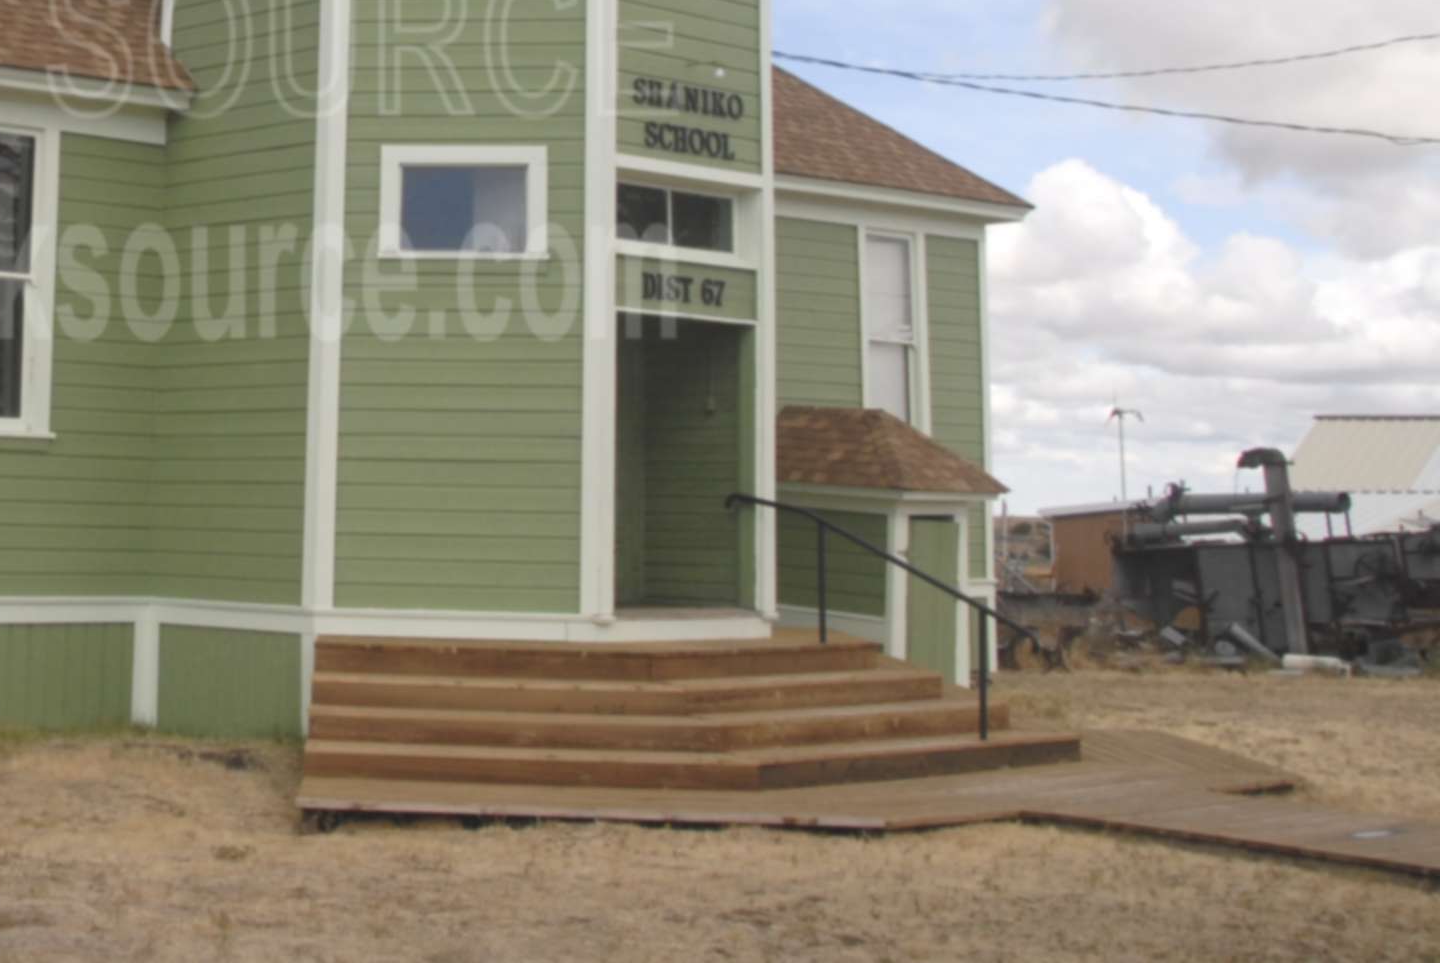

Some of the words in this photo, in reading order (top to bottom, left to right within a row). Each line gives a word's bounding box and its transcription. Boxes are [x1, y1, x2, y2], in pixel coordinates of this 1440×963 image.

[632, 78, 743, 120] SHANIKO
[644, 121, 735, 160] SCHOOL
[641, 272, 693, 303] DIST
[700, 279, 726, 307] 67
